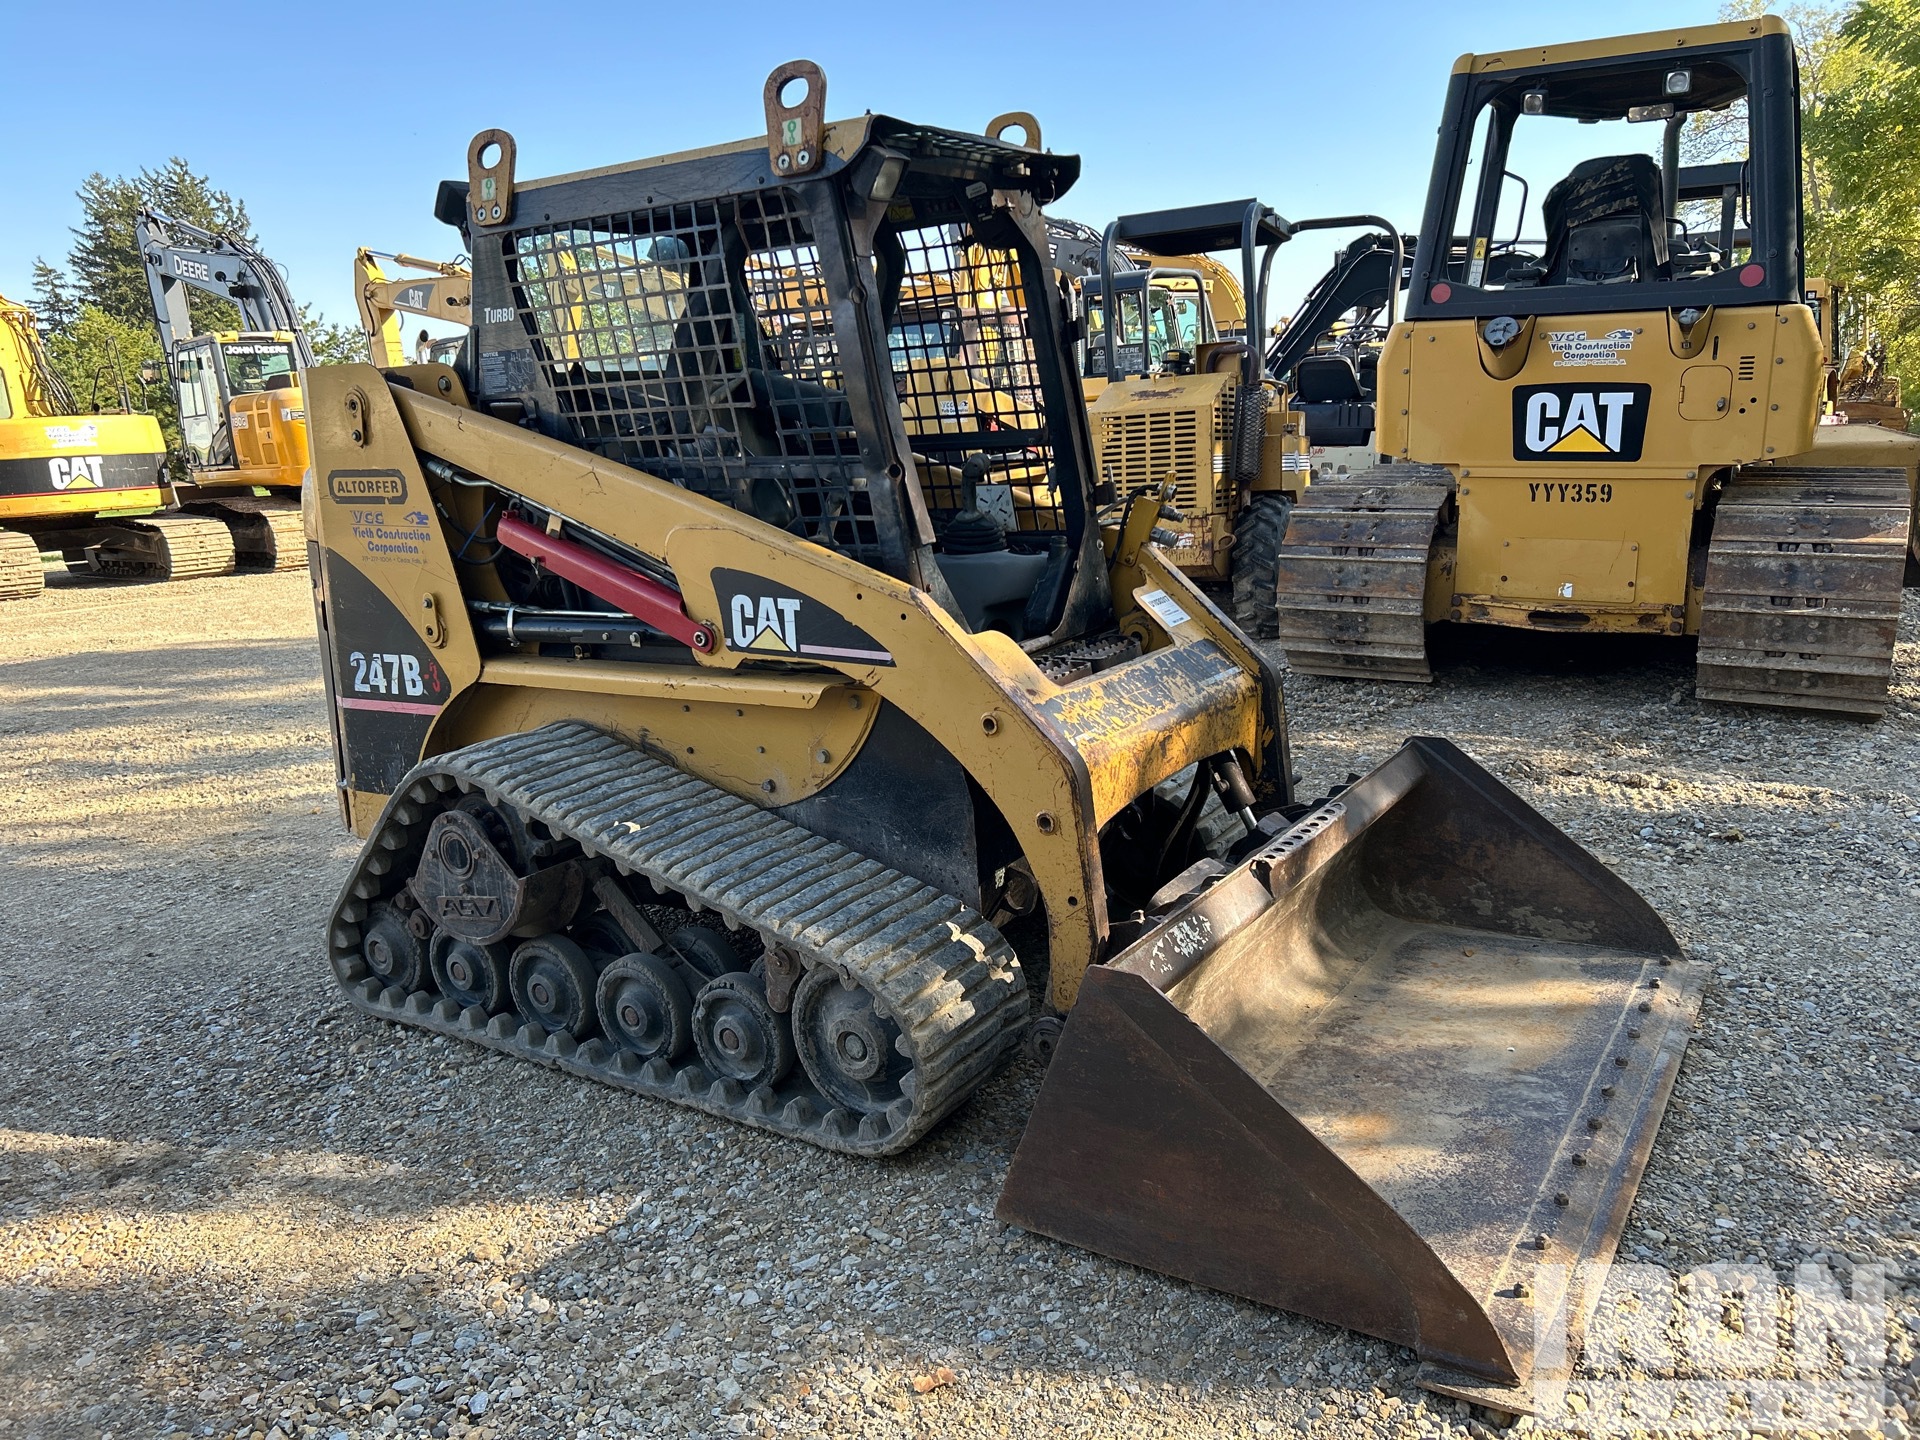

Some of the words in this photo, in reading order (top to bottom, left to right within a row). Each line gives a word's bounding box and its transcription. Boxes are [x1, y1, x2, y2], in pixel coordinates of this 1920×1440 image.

[173, 255, 209, 281] DEERE
[408, 289, 424, 309] CAT
[484, 307, 514, 324] TURBO
[1551, 331, 1586, 342] VCC
[225, 345, 254, 355] JOHN
[255, 345, 289, 354] DEERE
[1551, 343, 1572, 351] Vieth
[1575, 342, 1631, 351] Construction
[1563, 351, 1616, 361] Corporation
[1525, 391, 1634, 453] CAT
[48, 456, 104, 490] CAT
[337, 480, 399, 494] ALTORFER
[1529, 483, 1613, 503] YYY359
[350, 510, 384, 525] VCC
[352, 526, 374, 539] Vieth
[376, 528, 431, 542] Construction
[367, 540, 419, 555] Corporation
[731, 594, 801, 653] CAT
[350, 651, 425, 697] 247B
